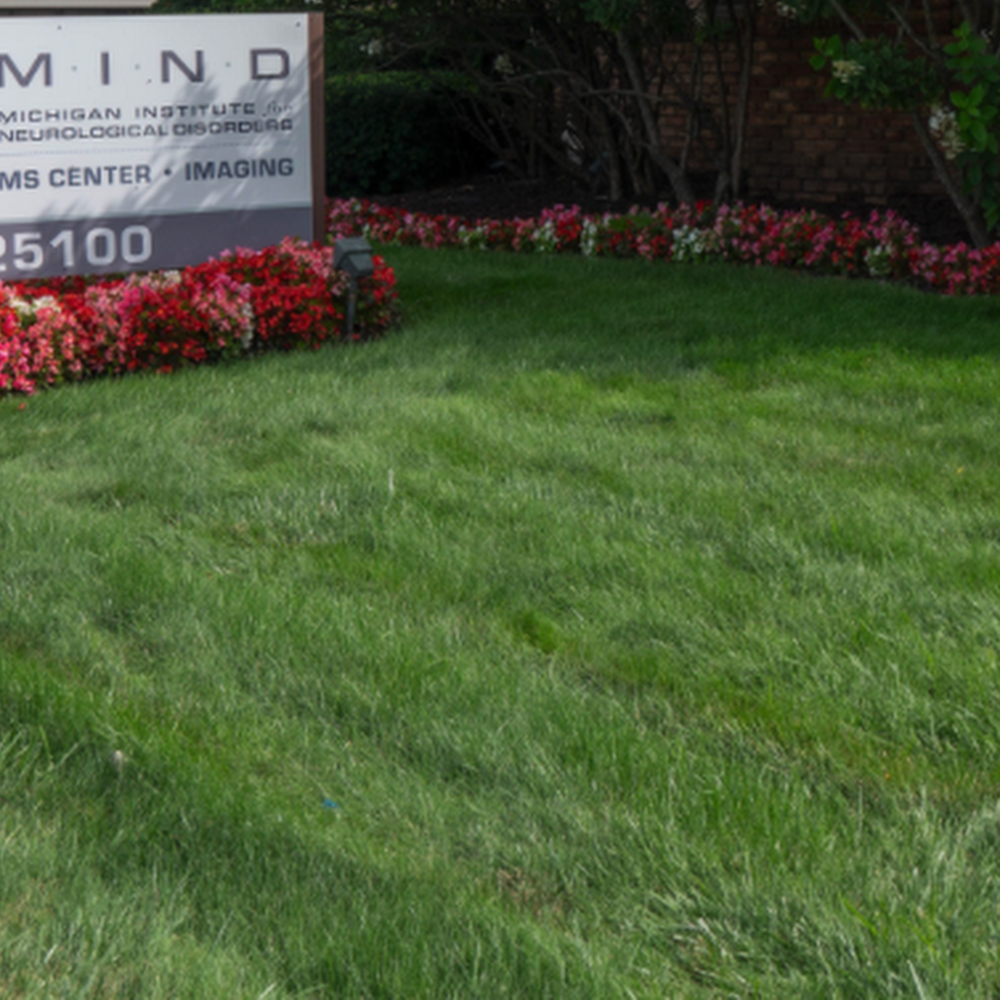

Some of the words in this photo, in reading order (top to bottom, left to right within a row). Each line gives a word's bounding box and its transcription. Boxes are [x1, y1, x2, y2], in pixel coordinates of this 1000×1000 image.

[0, 107, 122, 124] MICHIGAN
[134, 102, 256, 119] INSTITUTE
[0, 124, 169, 142] NEUROLOGICAL
[172, 118, 293, 137] DISORDERS
[0, 169, 40, 190] MS
[48, 164, 151, 188] CENTER
[184, 157, 294, 181] IMAGING
[0, 225, 152, 271] 5100
